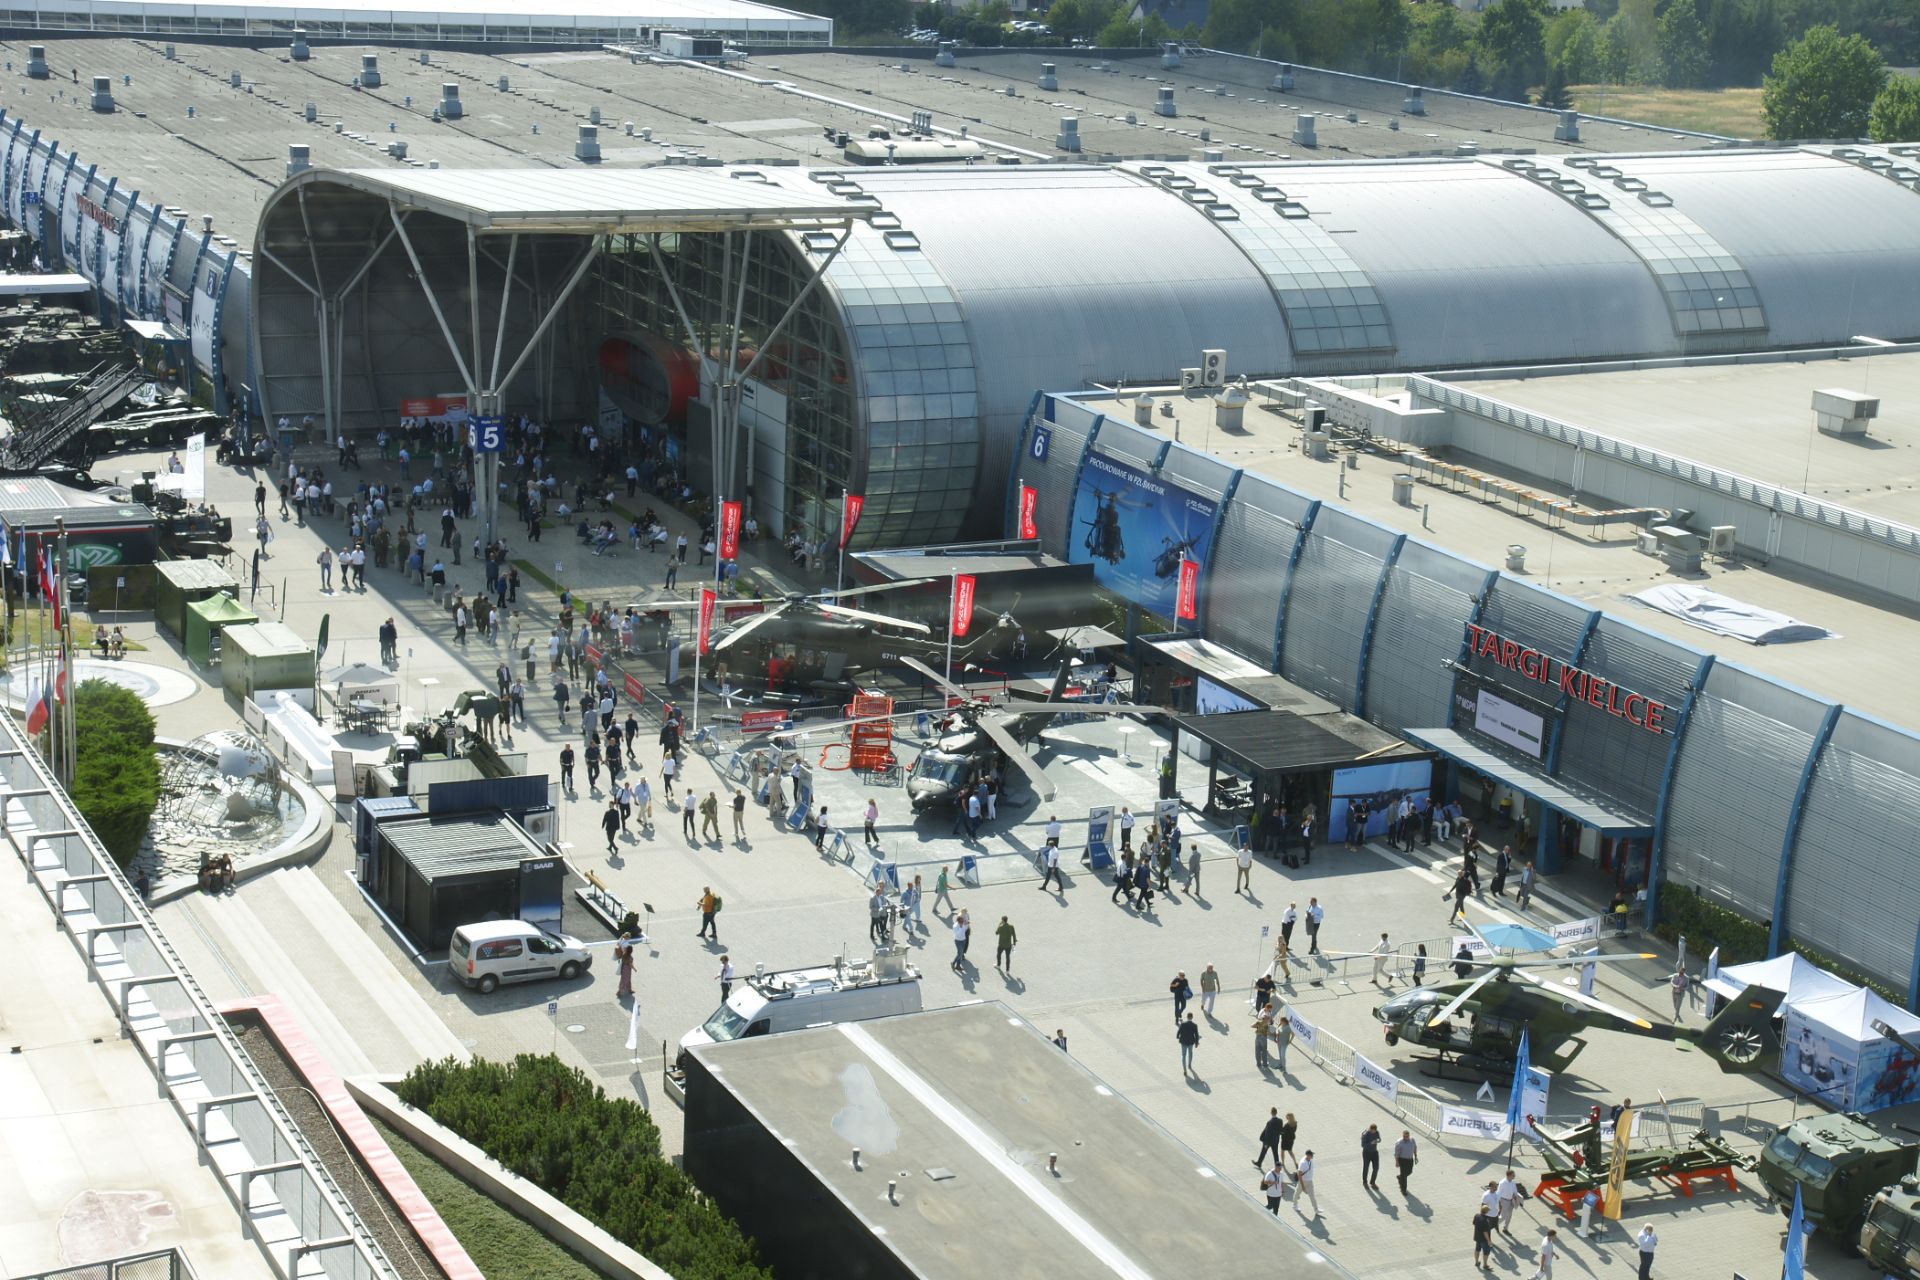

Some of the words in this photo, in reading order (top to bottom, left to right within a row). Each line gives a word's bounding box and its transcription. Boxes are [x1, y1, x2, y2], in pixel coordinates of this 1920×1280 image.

[469, 424, 476, 447] 5
[482, 426, 500, 449] 5
[1034, 435, 1044, 457] 6
[1089, 456, 1127, 480] PRODUKOWANE
[1127, 473, 1135, 483] W
[1467, 623, 1550, 684] TARGI
[1559, 664, 1666, 734] KIELCE
[533, 862, 554, 870] SAAB
[1556, 924, 1593, 940] AIRBUS
[1289, 1015, 1312, 1041] AIRBUS
[1361, 1066, 1392, 1091] AIRBUS
[1447, 1116, 1501, 1132] AIRBUS
